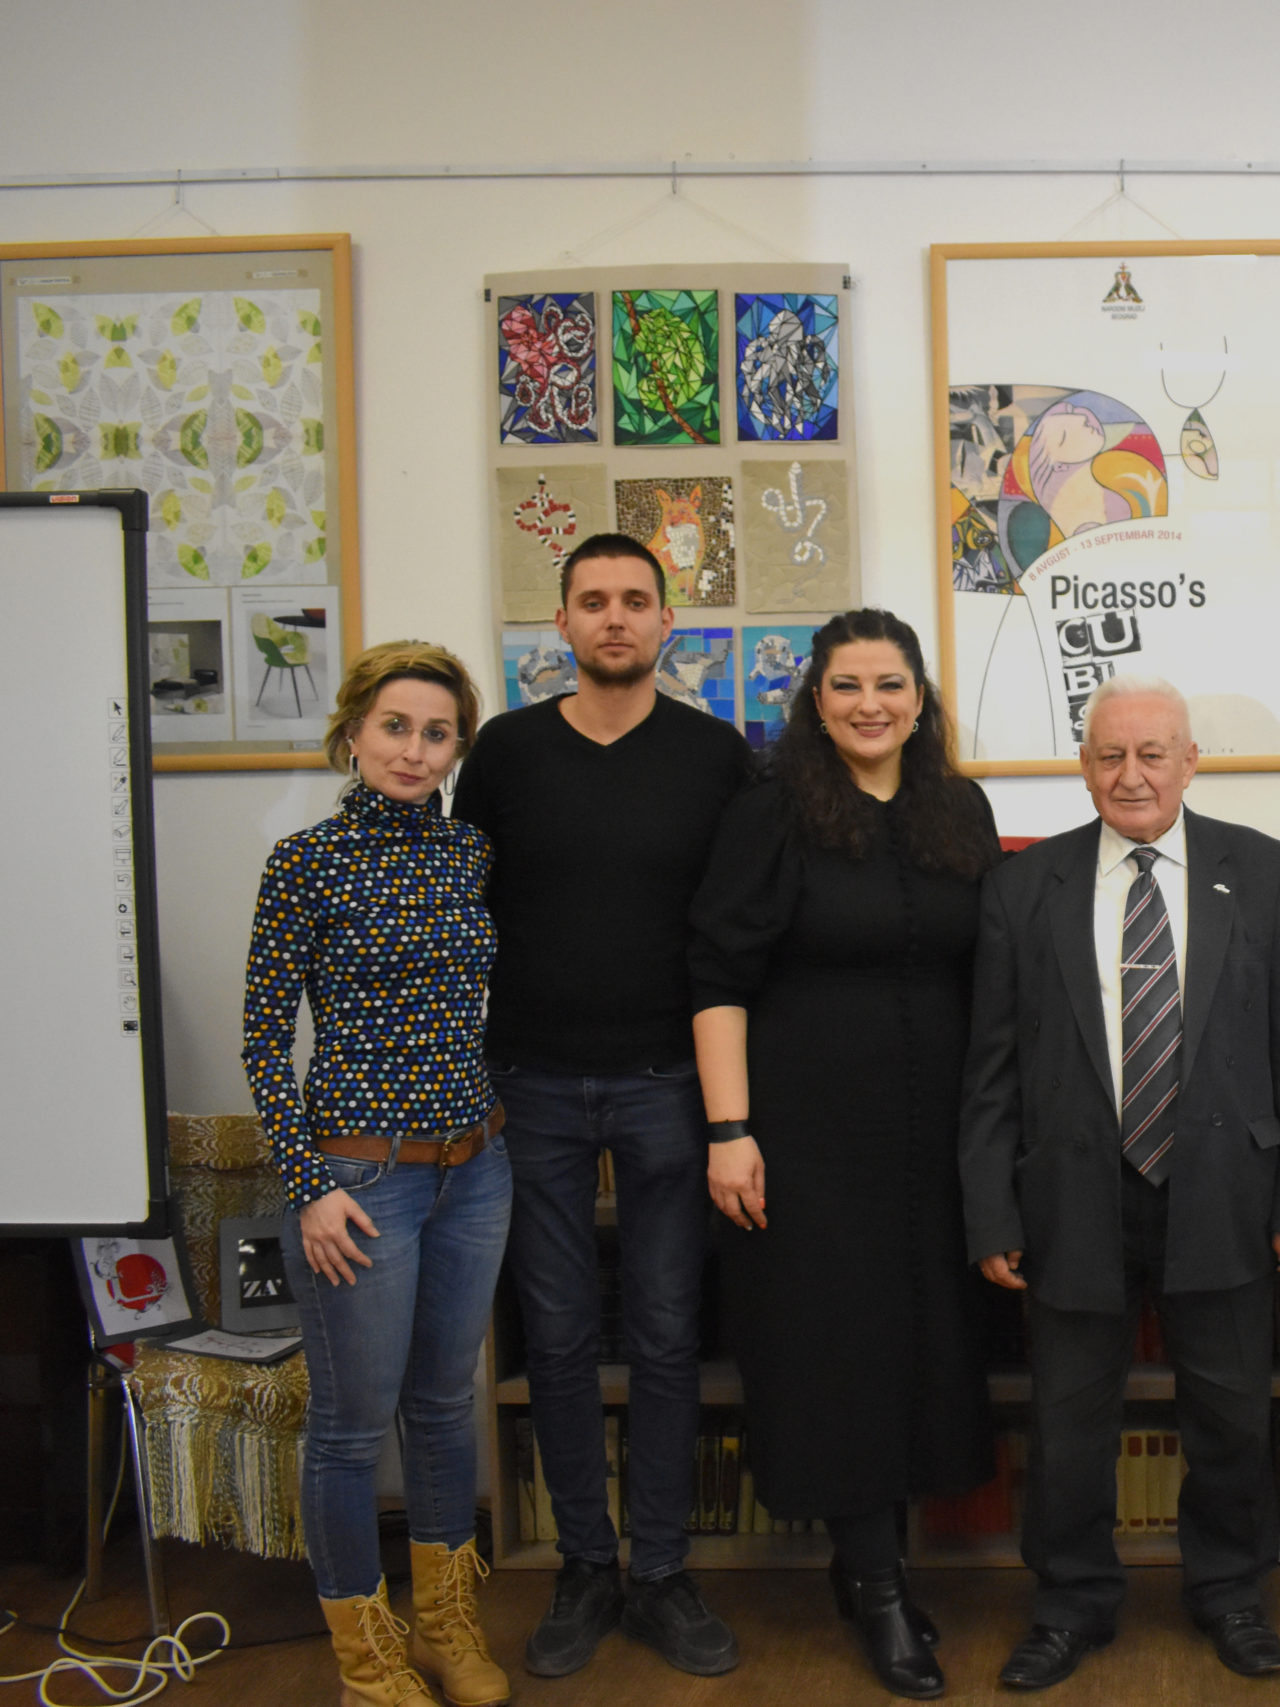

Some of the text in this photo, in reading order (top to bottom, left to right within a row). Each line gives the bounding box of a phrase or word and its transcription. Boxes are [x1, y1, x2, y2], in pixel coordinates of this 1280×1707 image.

[1035, 547, 1071, 576] AVGUST
[1080, 540, 1093, 549] 13
[1095, 530, 1154, 546] SEPTEMBAR
[1157, 530, 1182, 541] 2014
